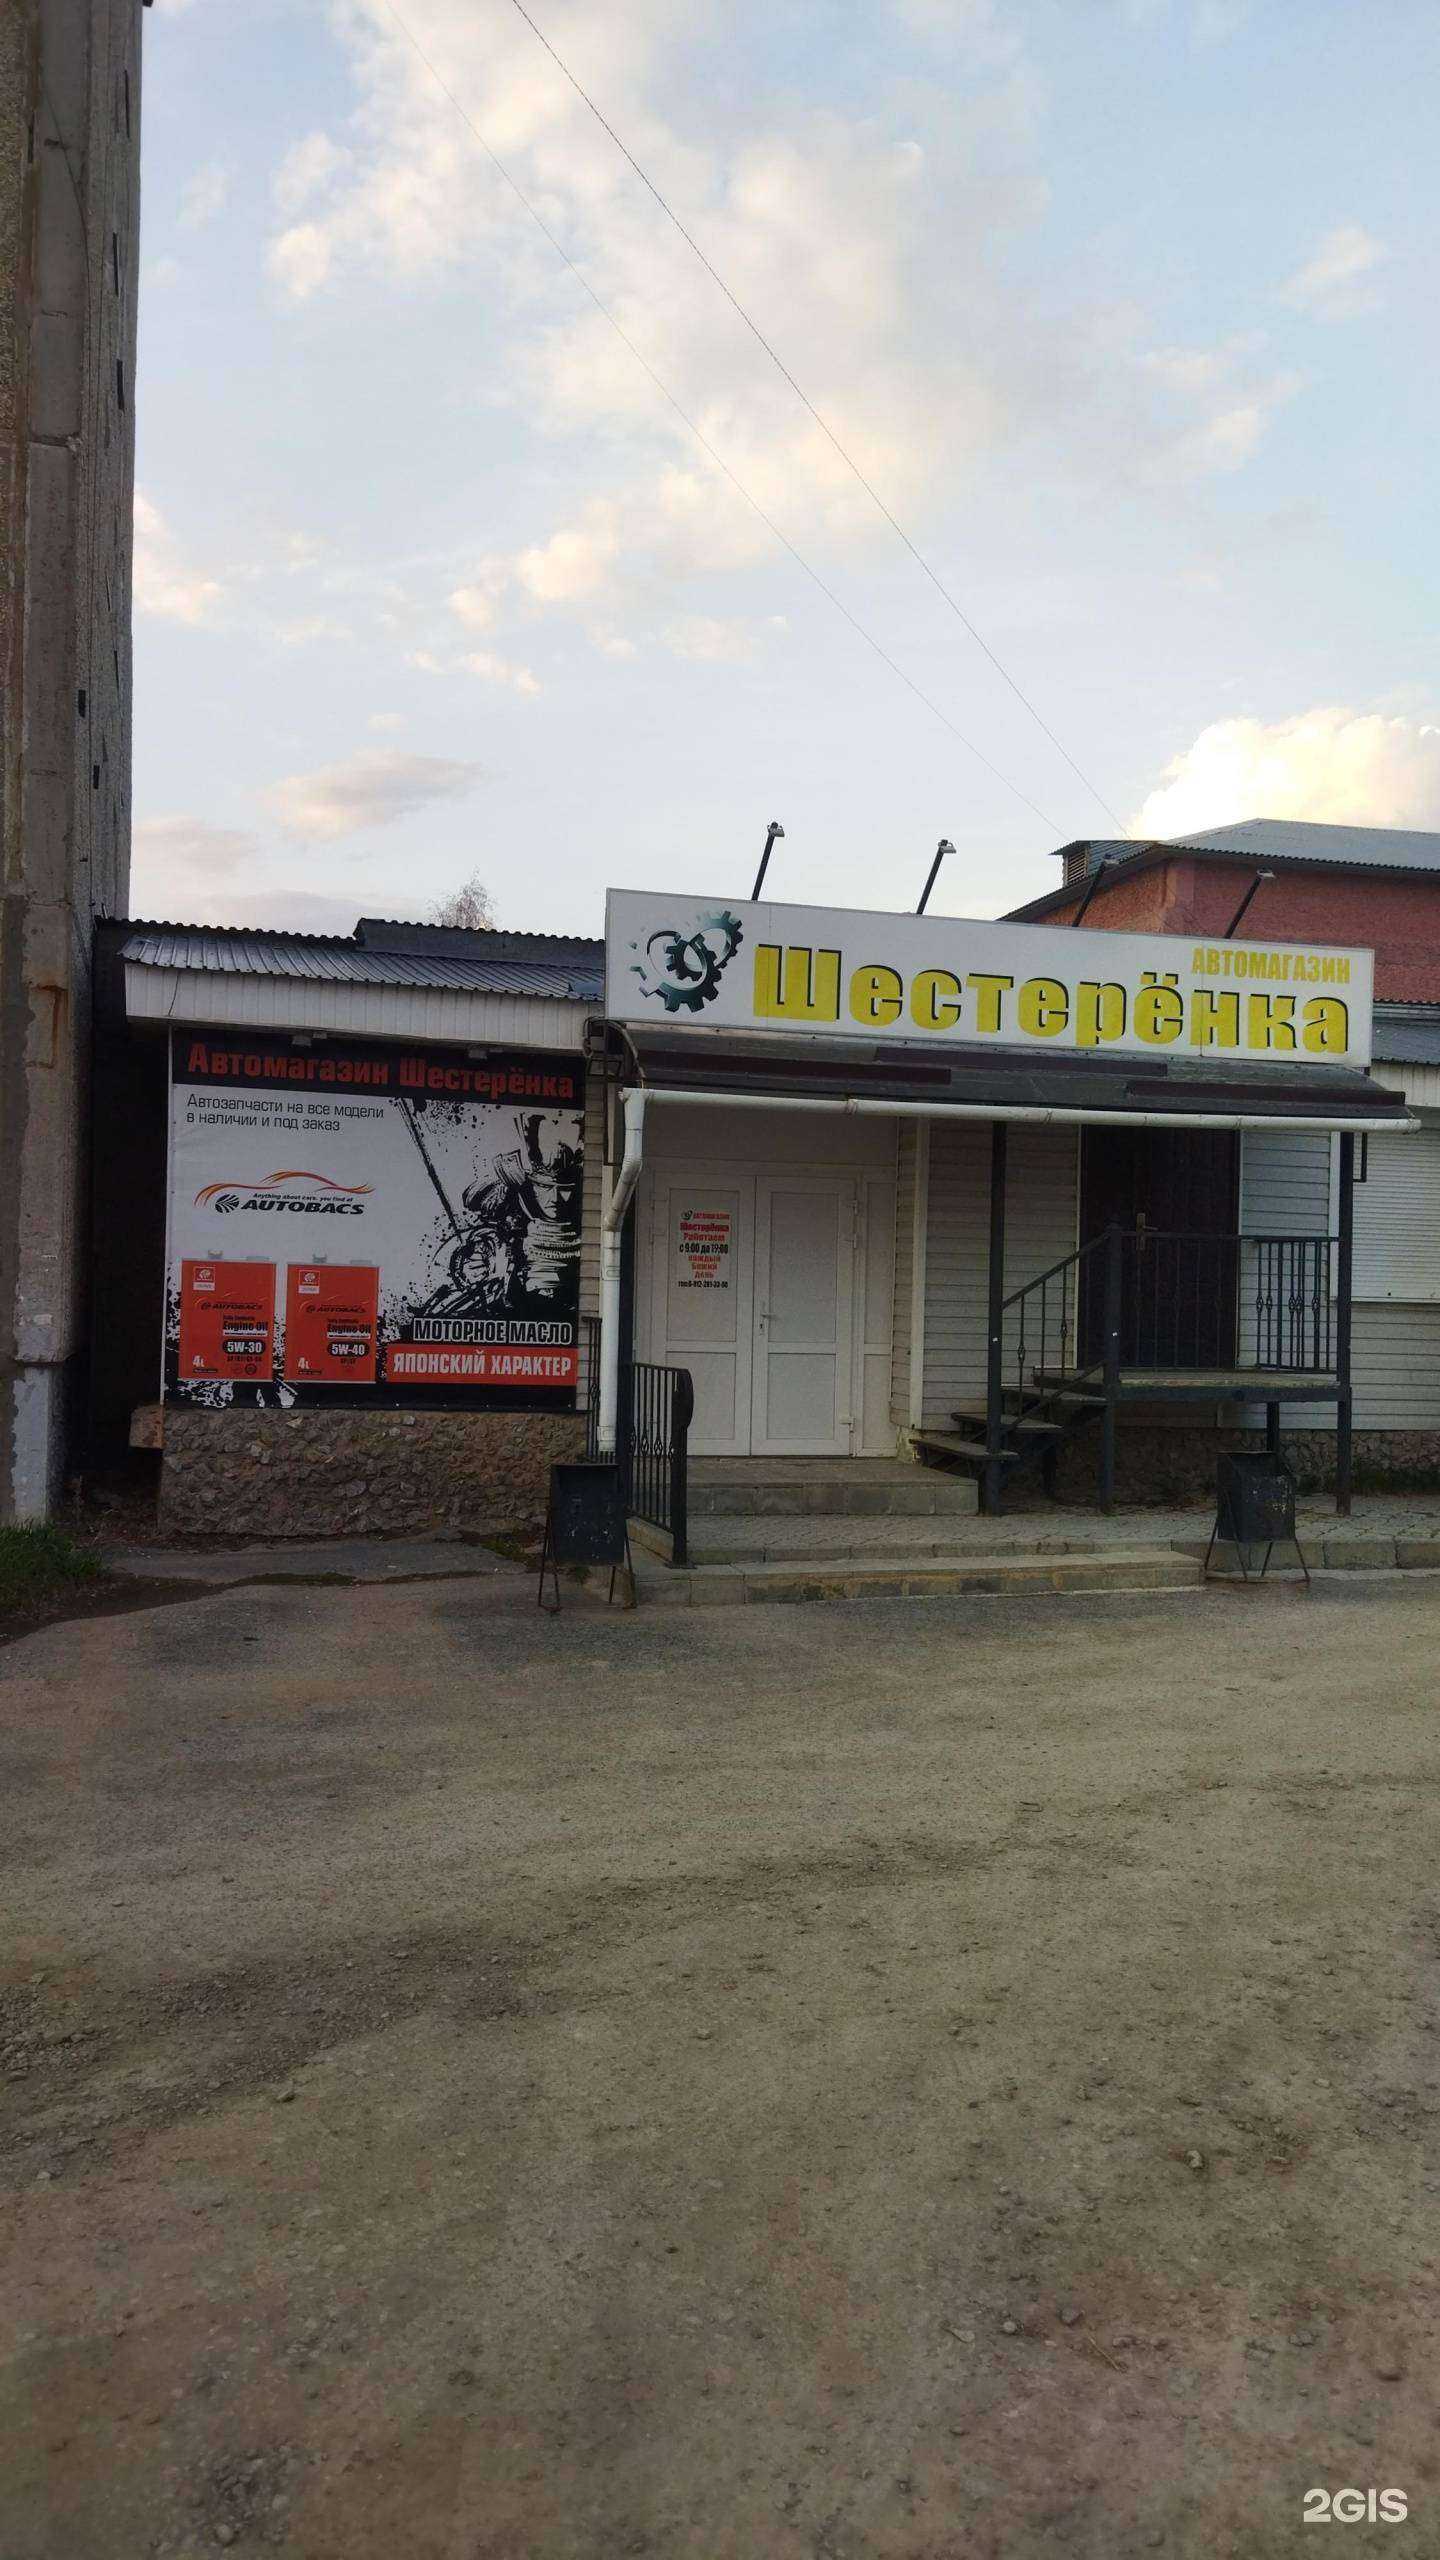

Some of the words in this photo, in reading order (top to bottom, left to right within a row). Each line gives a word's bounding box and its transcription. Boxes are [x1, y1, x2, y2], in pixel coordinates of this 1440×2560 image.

[1191, 947, 1350, 984] АВТОМАГАЗИН
[753, 943, 1349, 1054] Шестерёнка
[188, 1043, 389, 1084] Автомагазин
[399, 1057, 574, 1099] Шестерёнка
[187, 1093, 283, 1112] Автозапчасти
[287, 1103, 303, 1114] на
[308, 1103, 330, 1115] все
[334, 1106, 384, 1119] модели
[187, 1112, 194, 1123] в
[199, 1112, 257, 1126] наличии
[262, 1116, 269, 1126] и
[274, 1117, 299, 1130] под
[302, 1119, 340, 1131] заказ
[241, 1199, 365, 1215] AUTOBACS
[413, 1318, 507, 1343] МОТОРНОЕ
[509, 1321, 572, 1345] МАСЛО
[227, 1341, 262, 1353] 5W-30
[331, 1344, 365, 1355] 5W-40
[393, 1347, 485, 1375] ЯПОНСКИЙ
[490, 1355, 571, 1377] ХАРАКТЕР
